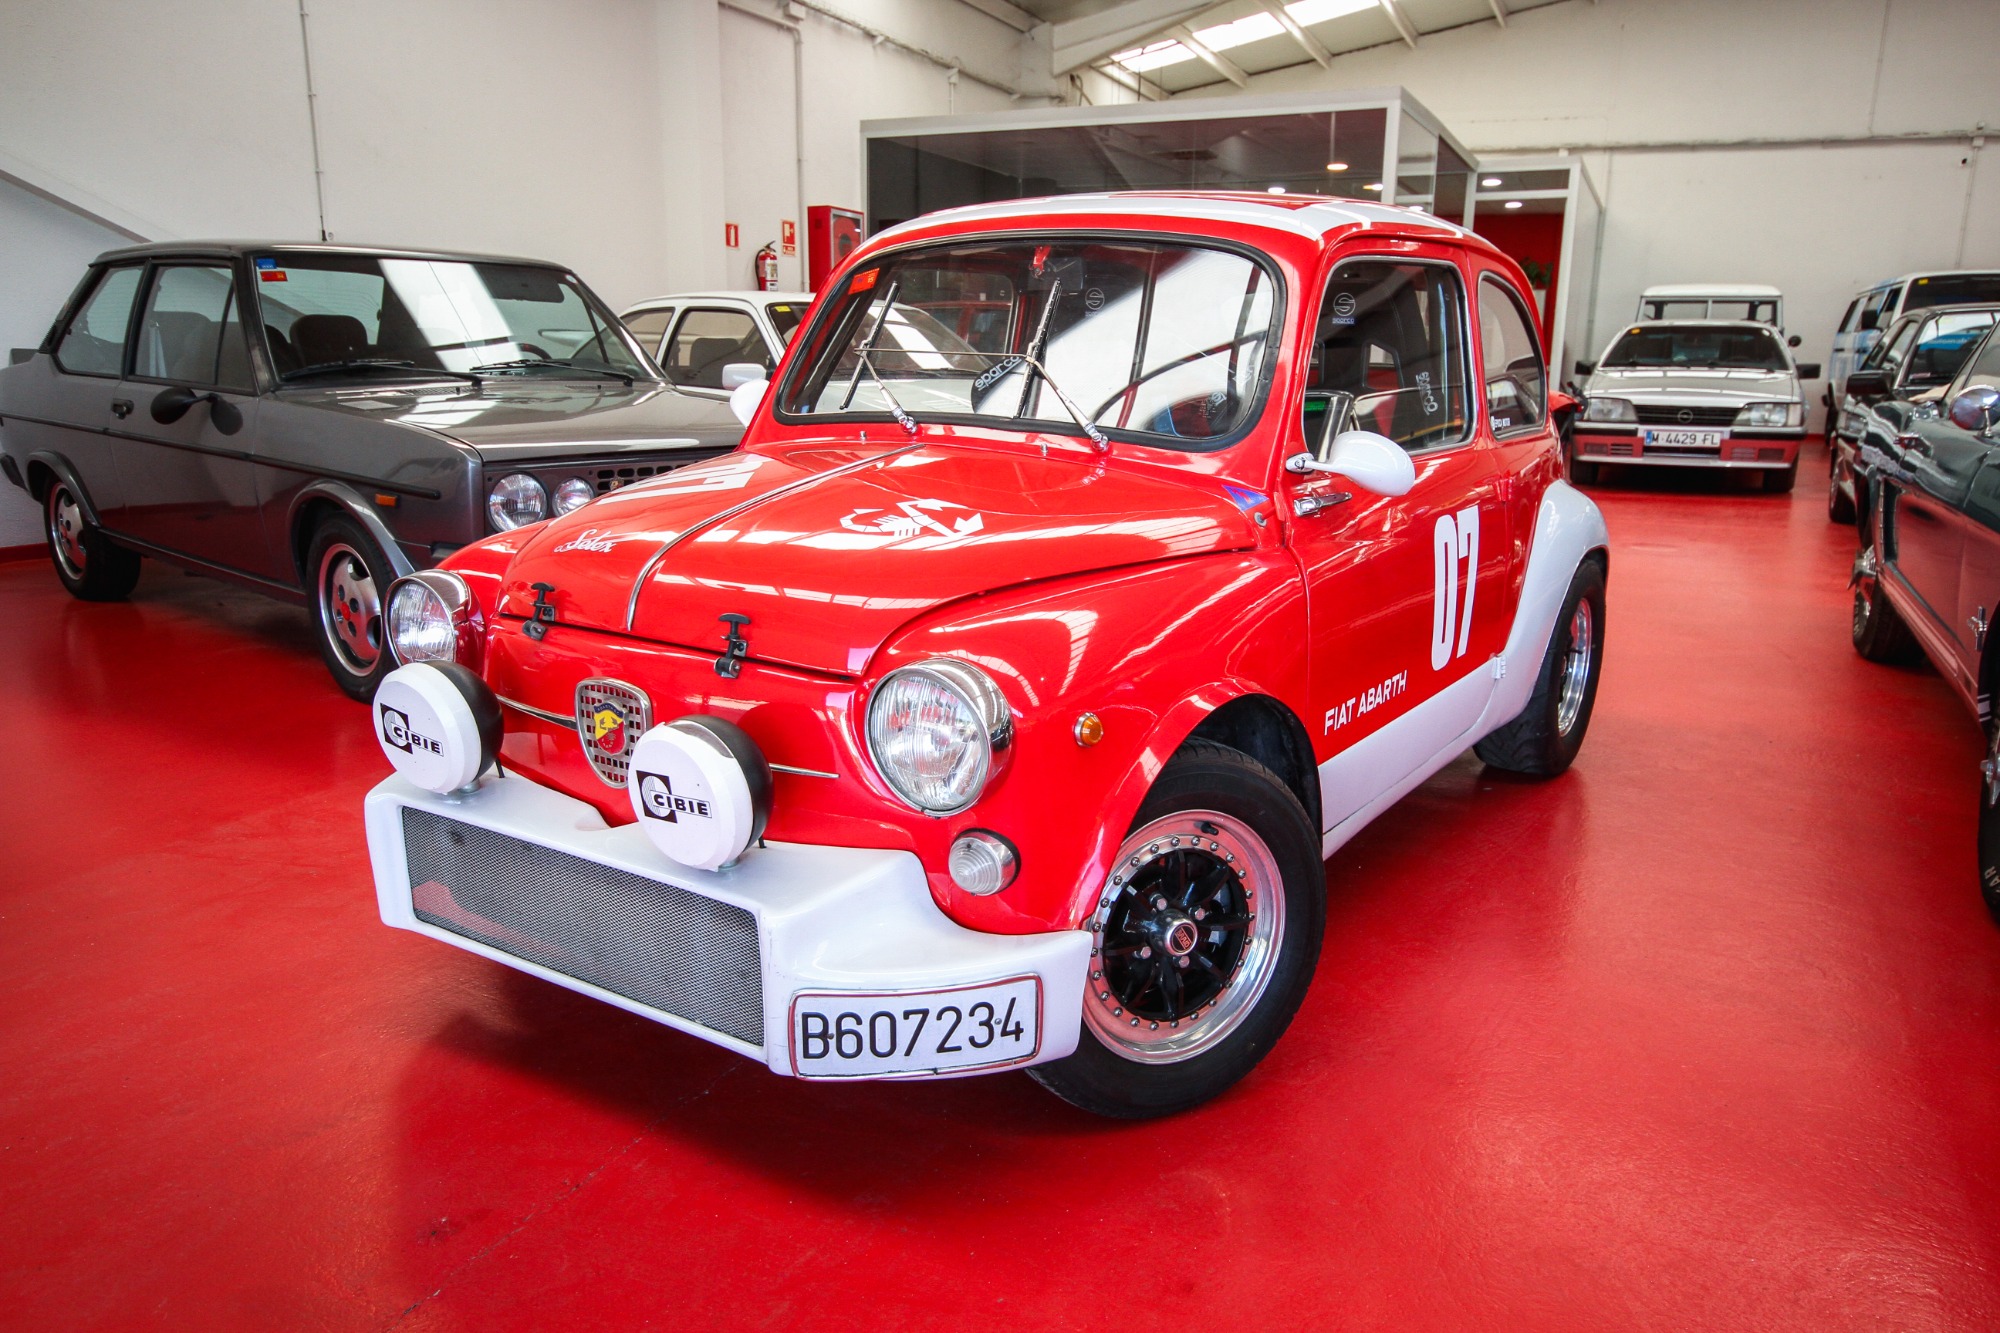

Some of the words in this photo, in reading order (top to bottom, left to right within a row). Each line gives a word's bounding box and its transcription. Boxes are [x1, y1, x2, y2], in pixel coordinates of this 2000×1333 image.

[1652, 432, 1660, 443] M
[1666, 432, 1697, 445] 4429
[1702, 433, 1718, 446] FL
[1431, 505, 1479, 671] 07
[1324, 698, 1356, 736] FIAT
[1357, 670, 1407, 718] ABARTH
[394, 726, 440, 754] CIBIE
[653, 794, 708, 815] CIBIE
[801, 997, 1024, 1060] B607234
